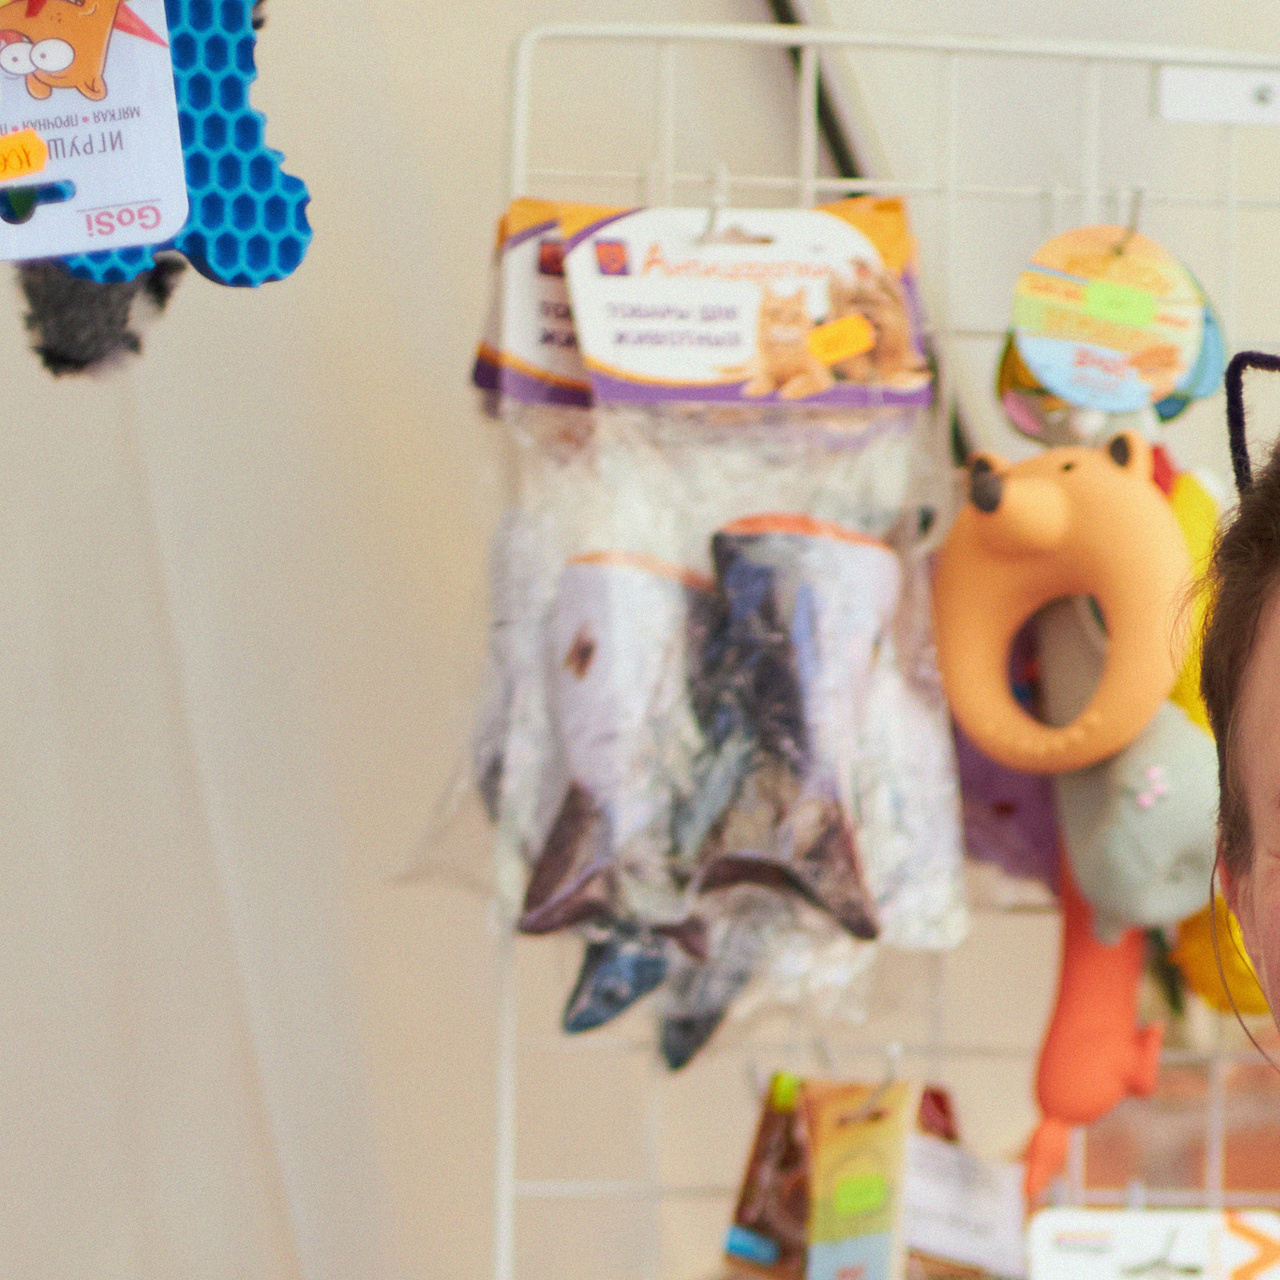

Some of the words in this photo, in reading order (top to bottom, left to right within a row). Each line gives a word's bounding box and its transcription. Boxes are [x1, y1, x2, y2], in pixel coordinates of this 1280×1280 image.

[92, 106, 141, 120] МЯГКАЯ
[48, 130, 124, 161] ИГРУШ
[86, 205, 162, 238] GoSi
